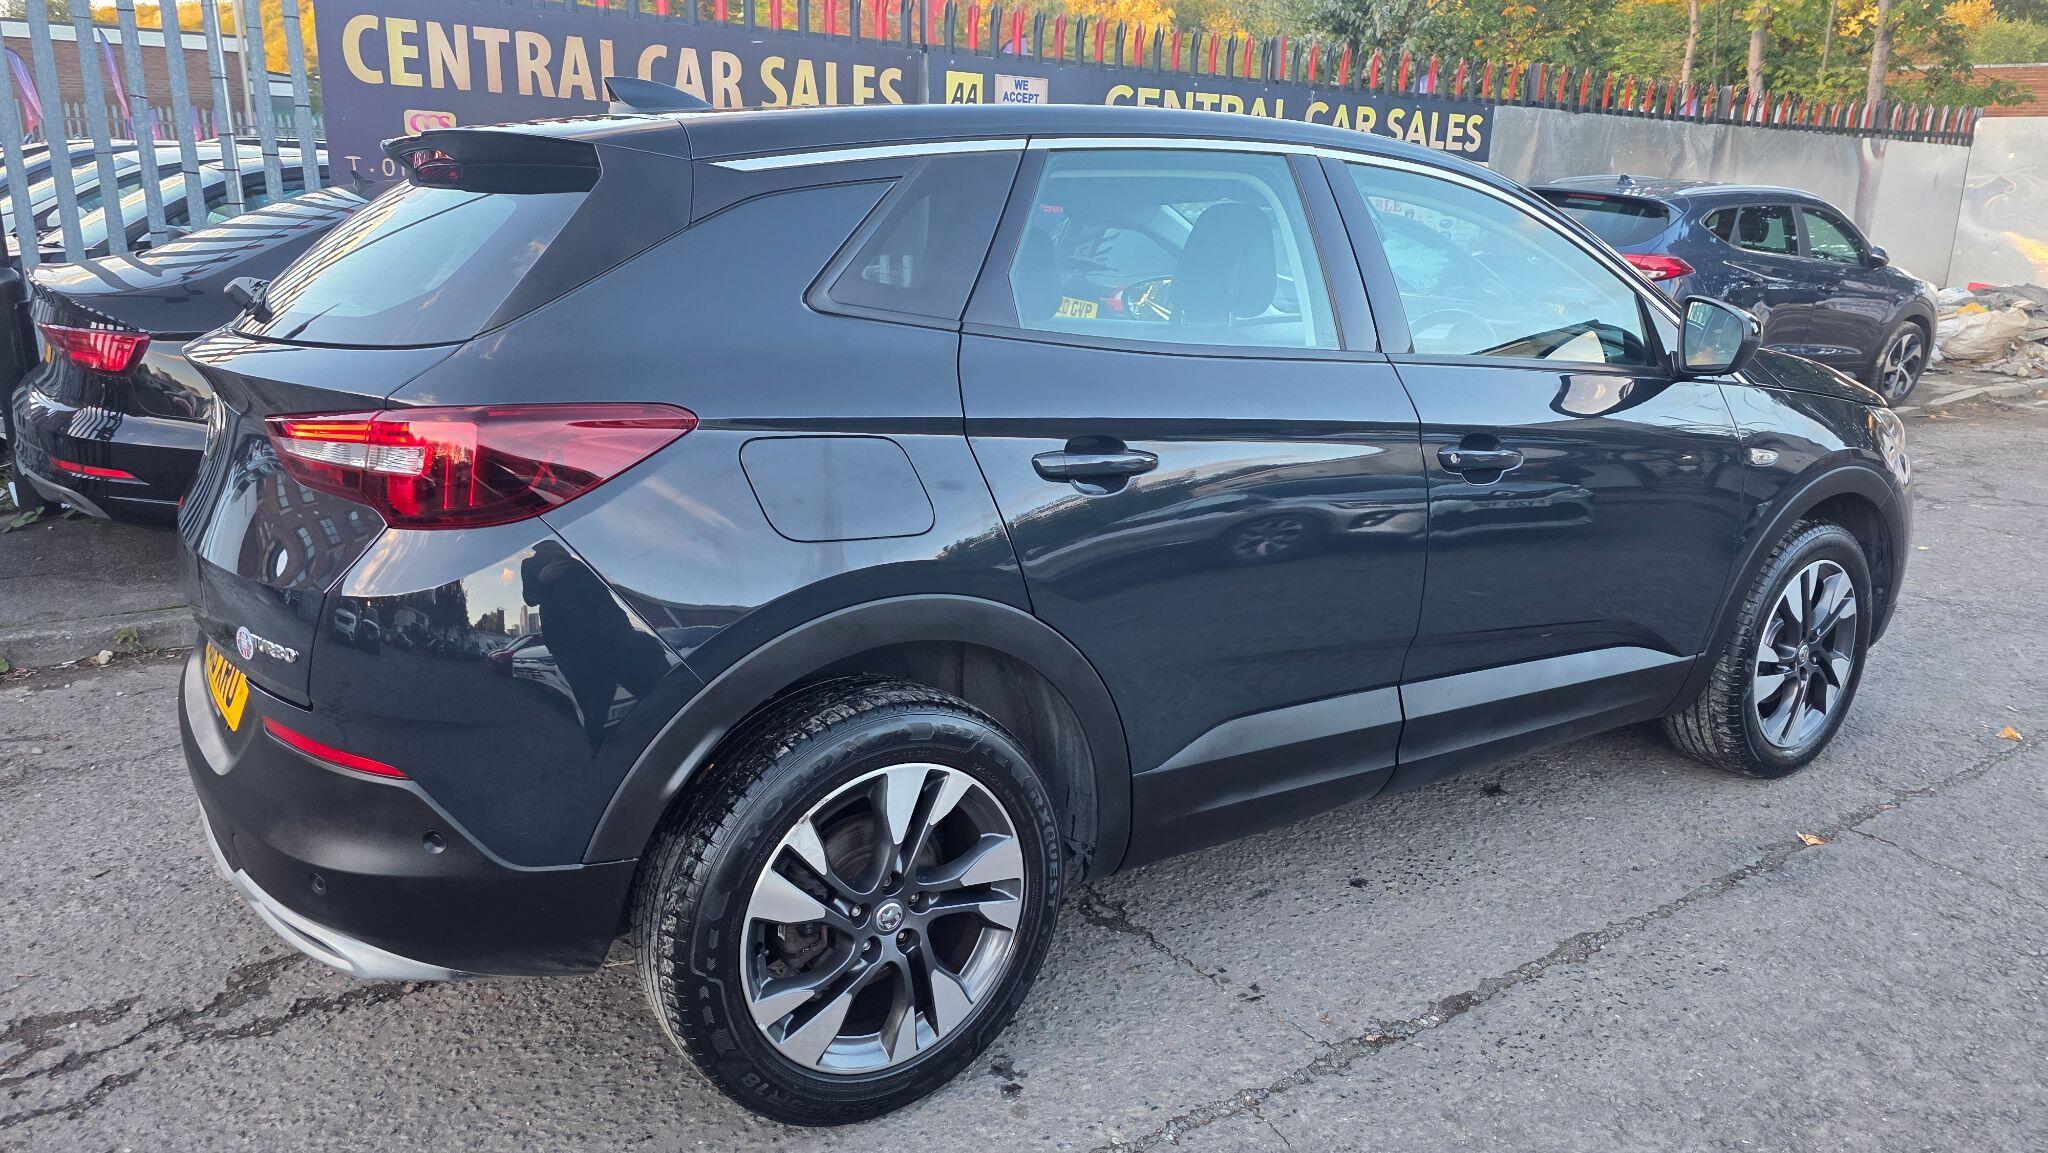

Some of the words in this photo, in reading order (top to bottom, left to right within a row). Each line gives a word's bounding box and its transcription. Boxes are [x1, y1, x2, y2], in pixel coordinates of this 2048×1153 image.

[342, 14, 615, 102] CENTRAL
[637, 44, 744, 108] CAR
[760, 55, 904, 107] SALES
[951, 82, 978, 104] AA
[1014, 79, 1029, 90] WE
[1002, 91, 1040, 104] ACCEPT
[1304, 101, 1377, 133] CAR
[1387, 108, 1484, 153] SALES
